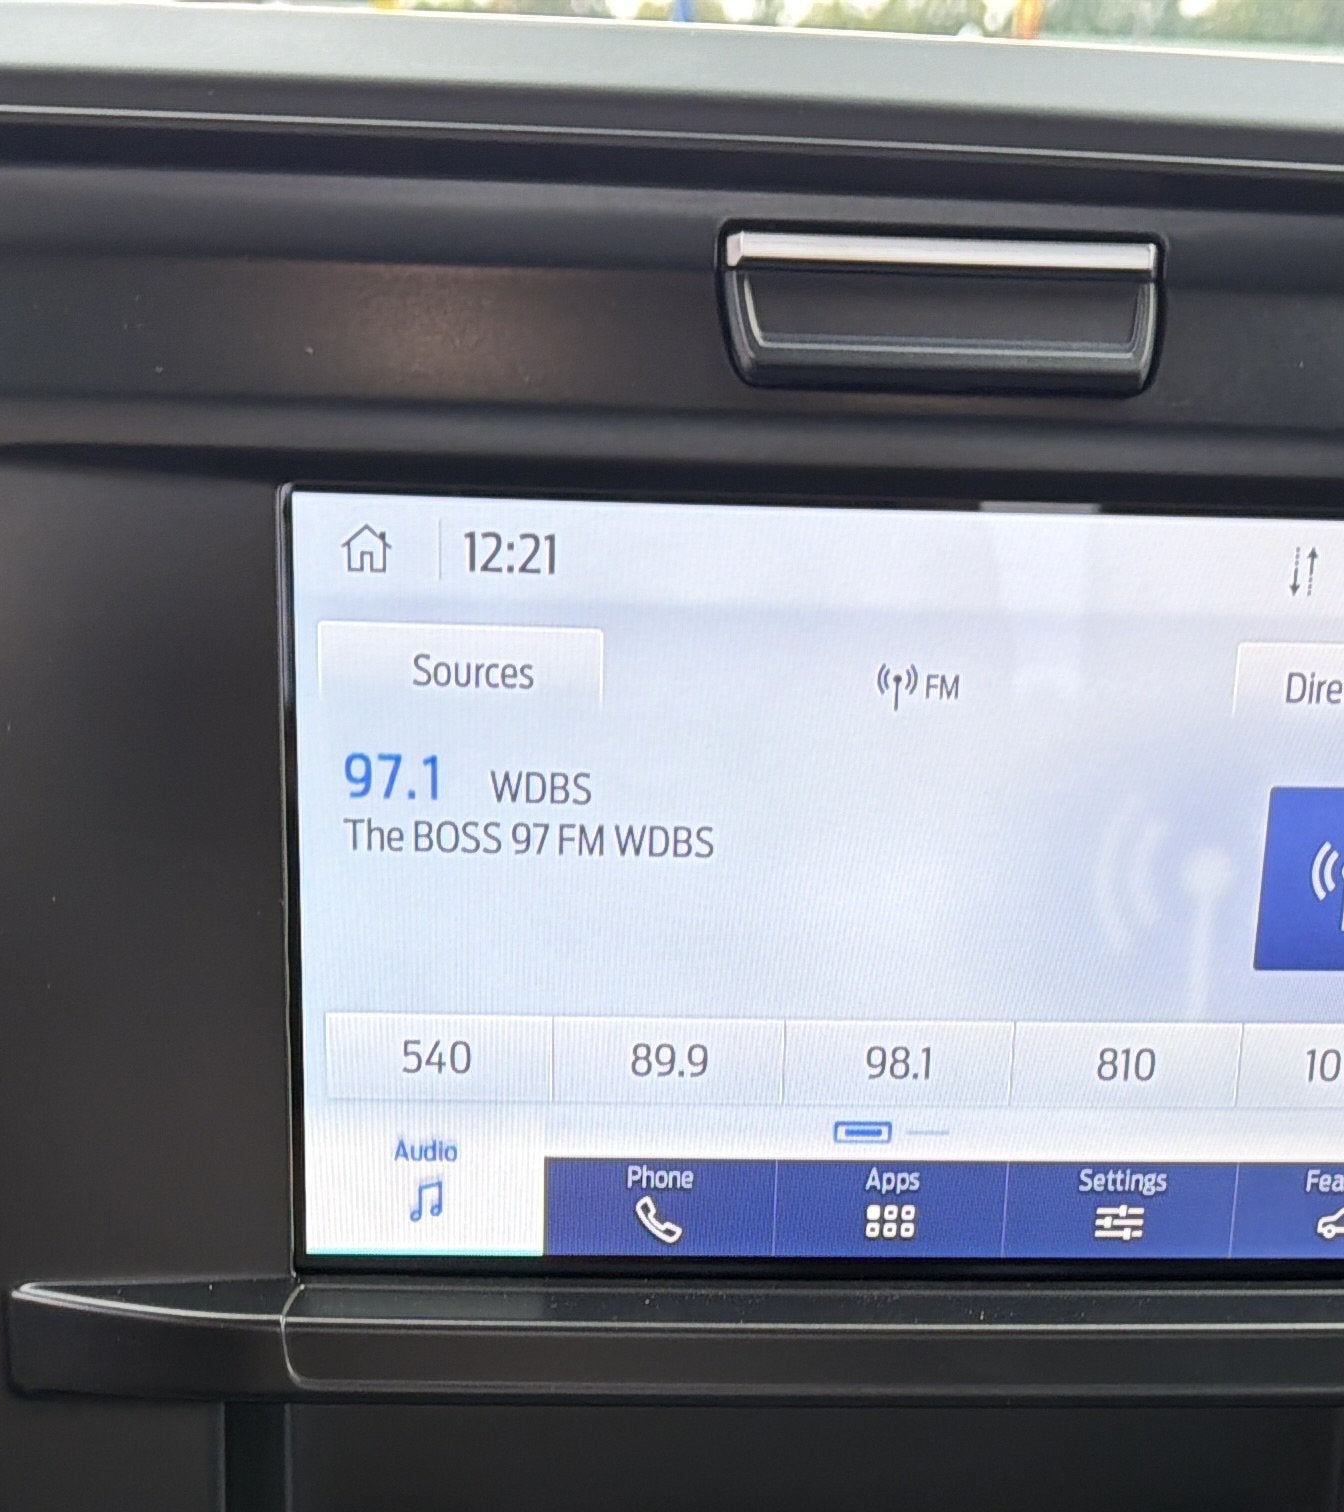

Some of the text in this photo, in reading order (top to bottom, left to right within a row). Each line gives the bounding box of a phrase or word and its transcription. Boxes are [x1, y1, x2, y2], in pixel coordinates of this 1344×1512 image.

[464, 531, 557, 575] 12:21
[412, 653, 535, 690] Sources
[925, 674, 960, 702] FM
[344, 753, 592, 805] 97.1 WDBS
[343, 818, 715, 858] The BOSS 97 FM WDBS
[401, 1039, 472, 1076] 540
[630, 1043, 709, 1078] 89.9
[865, 1046, 933, 1081] 98.1
[1096, 1048, 1157, 1082] 810
[394, 1138, 458, 1163] Audio
[626, 1164, 695, 1191] Phone
[865, 1166, 921, 1193] Apps
[1078, 1168, 1168, 1195] Settings
